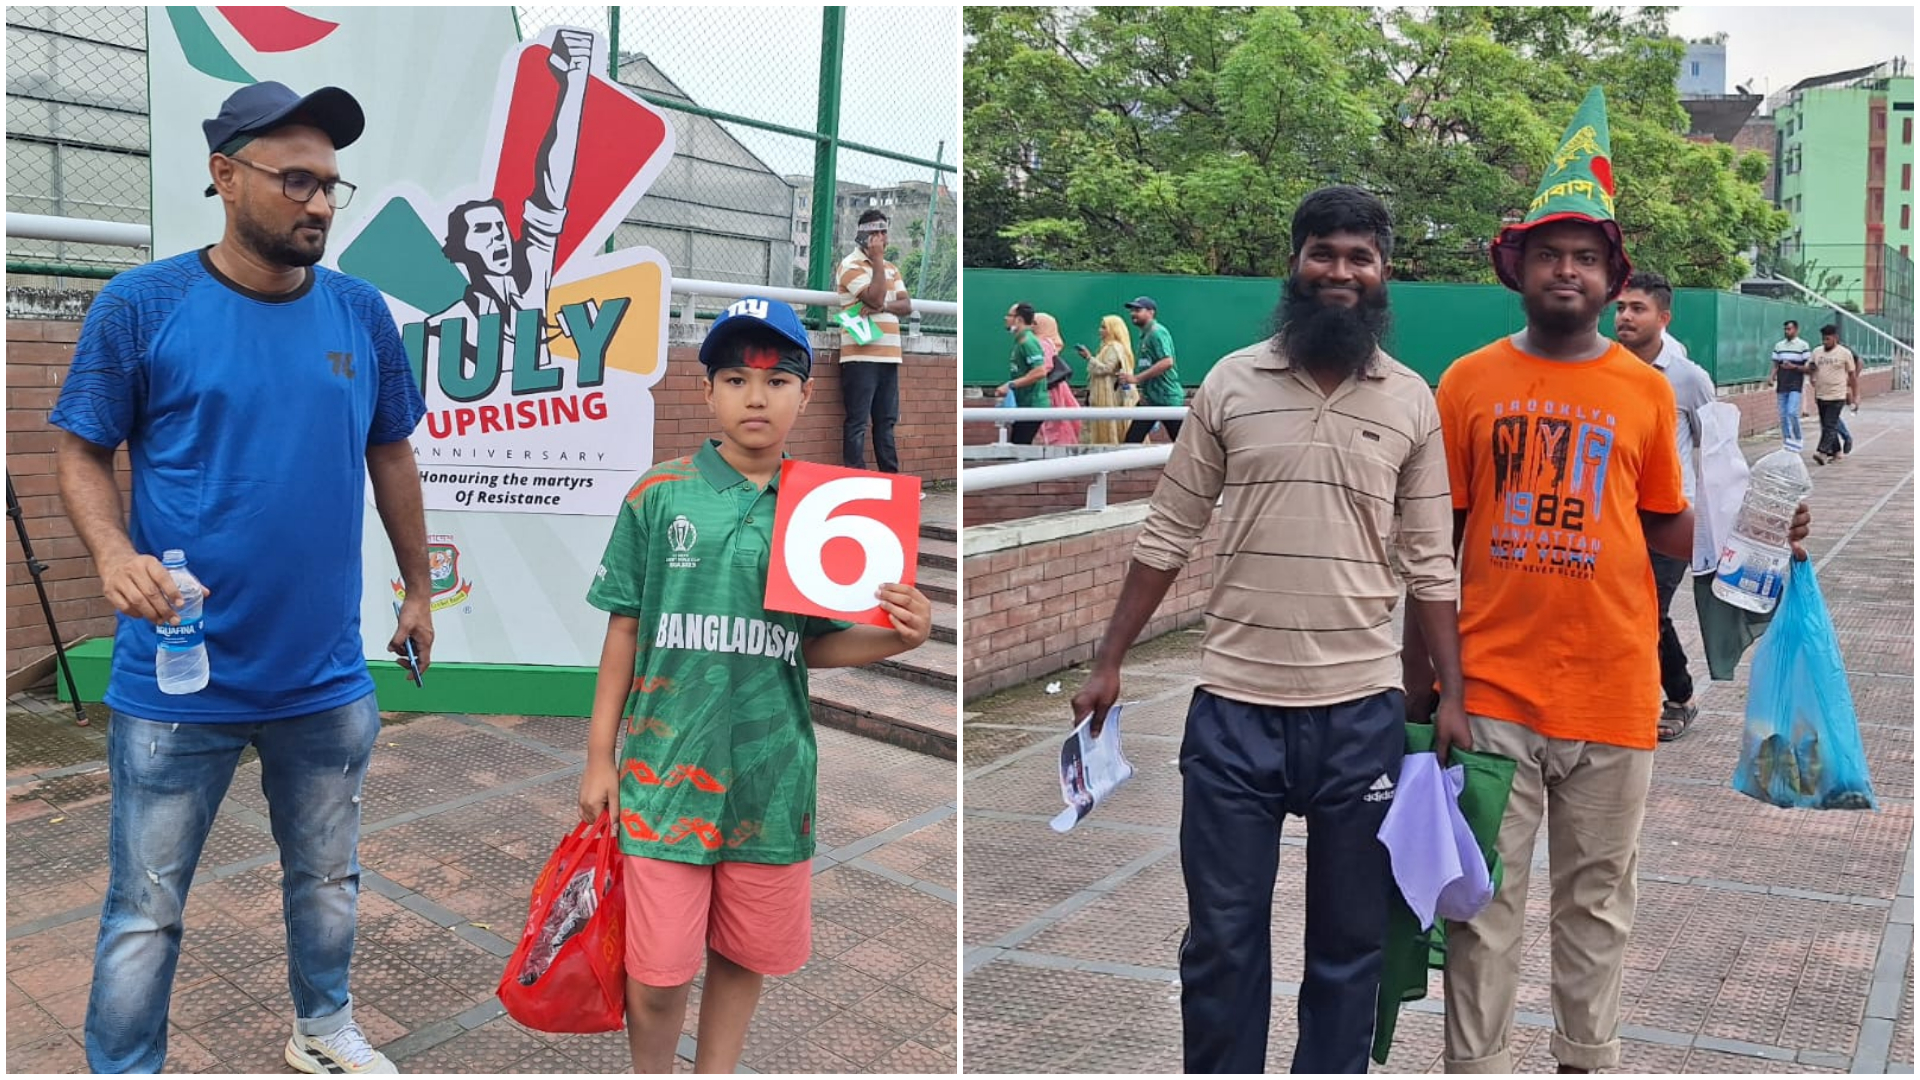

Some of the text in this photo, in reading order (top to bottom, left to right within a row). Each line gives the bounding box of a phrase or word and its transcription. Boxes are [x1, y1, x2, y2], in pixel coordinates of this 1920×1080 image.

[427, 391, 608, 439] UPRISING
[1494, 400, 1616, 427] BROOKLYN
[413, 447, 606, 462] ANNIVERSARY
[1494, 415, 1612, 488] NYC
[419, 470, 594, 490] Honouring the martyrs
[455, 490, 561, 506] Of Resistance
[1503, 491, 1584, 533] 1982
[784, 476, 905, 612] 6
[1491, 538, 1597, 572] NEW YORK
[655, 612, 800, 667] BANGLADESH
